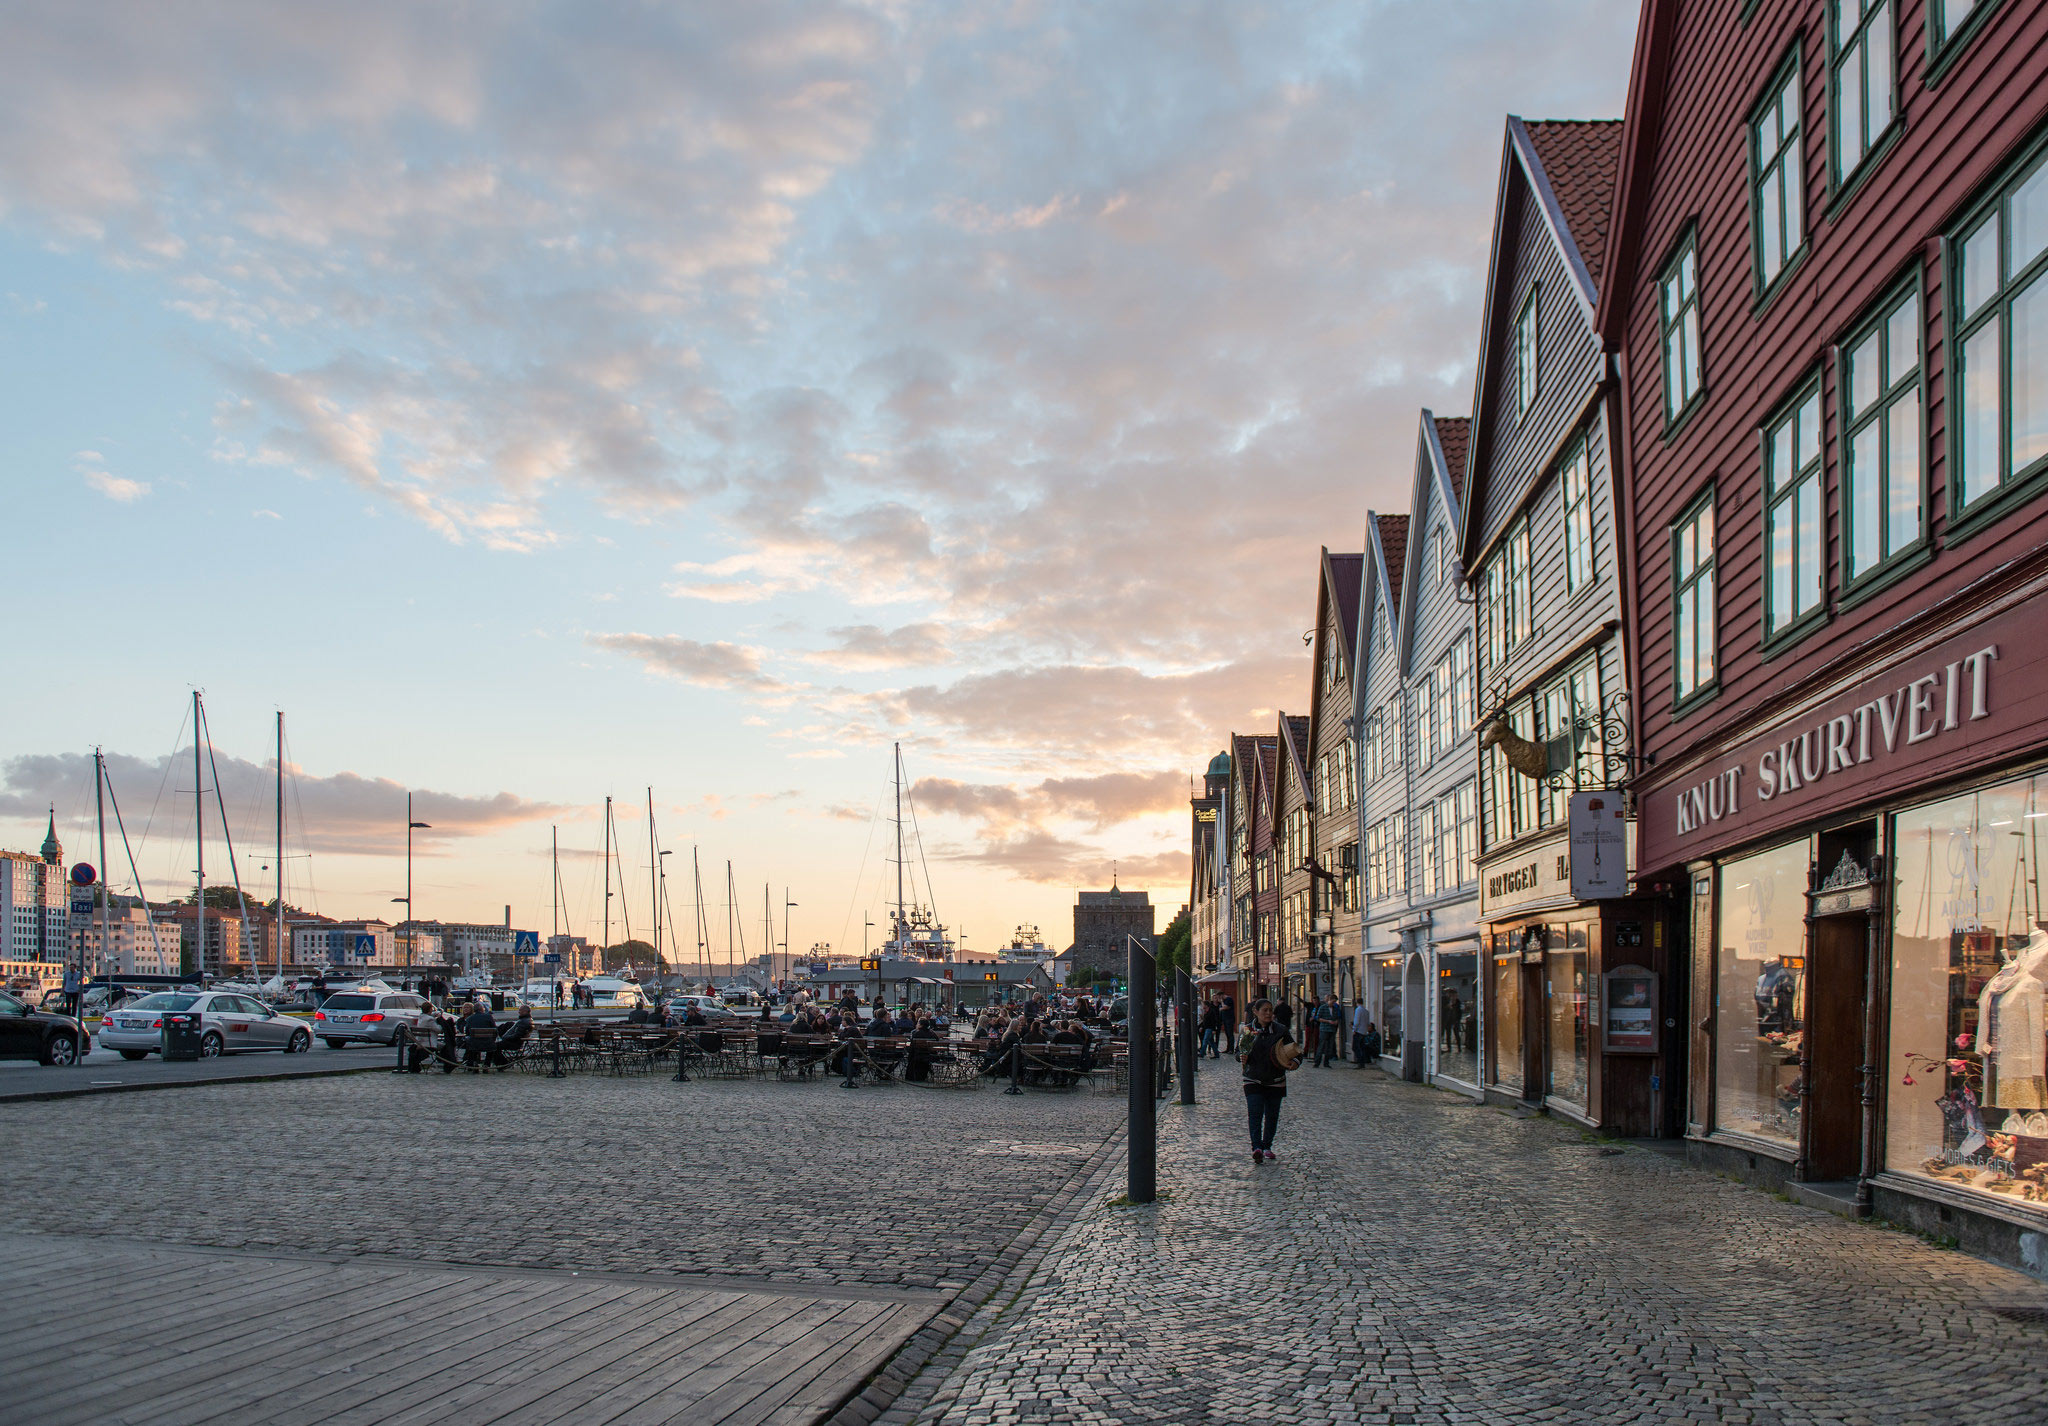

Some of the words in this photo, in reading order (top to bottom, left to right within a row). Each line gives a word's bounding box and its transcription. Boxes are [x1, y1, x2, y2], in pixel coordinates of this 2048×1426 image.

[1677, 765, 1744, 836] KNUT
[1758, 644, 2000, 801] SKURTVEIT
[1489, 863, 1537, 898] BRYGGEN
[73, 903, 92, 911] Taxi
[1947, 915, 1983, 934] VIKEN
[1926, 1144, 1975, 1168] MEMORIES
[1986, 1156, 2017, 1179] GIFTS
